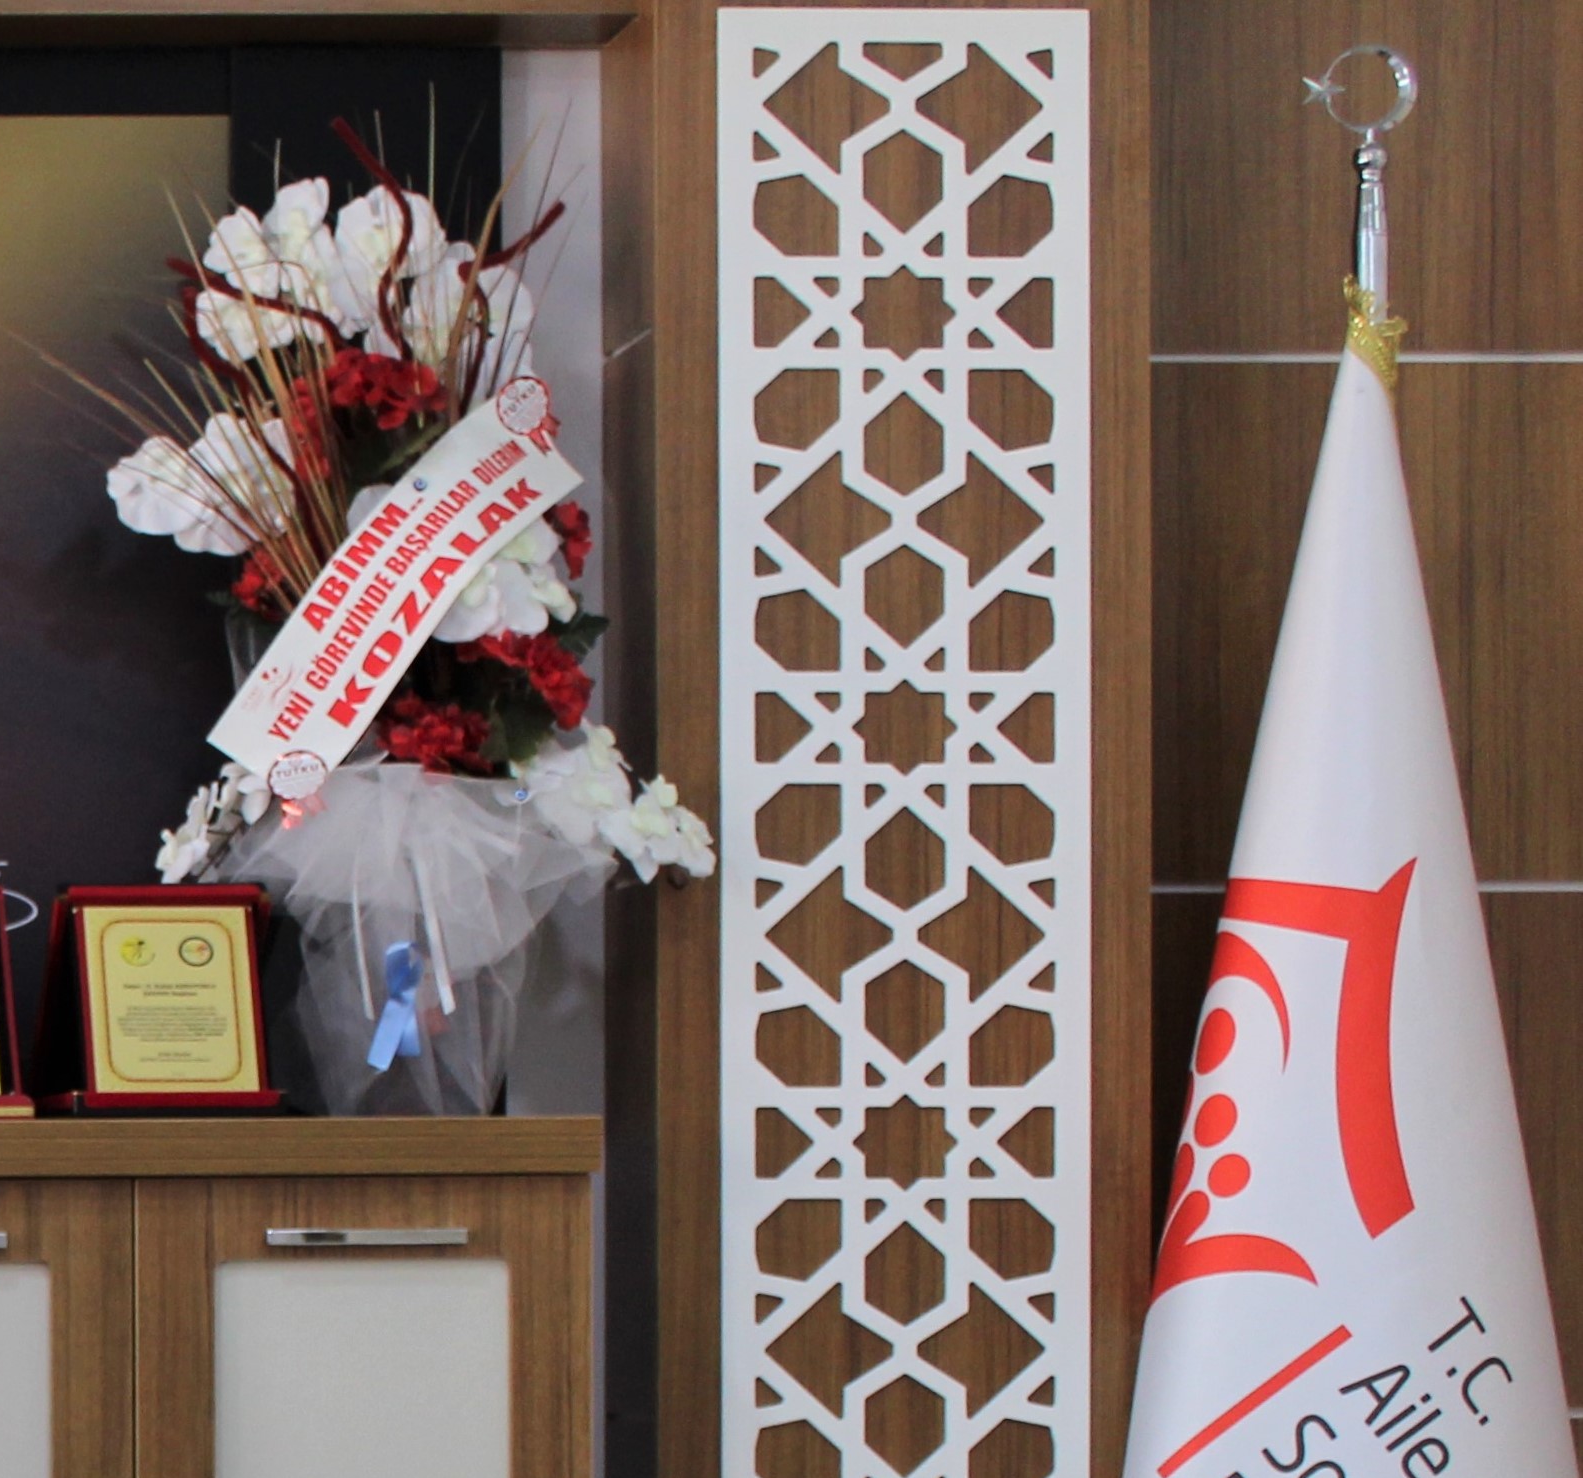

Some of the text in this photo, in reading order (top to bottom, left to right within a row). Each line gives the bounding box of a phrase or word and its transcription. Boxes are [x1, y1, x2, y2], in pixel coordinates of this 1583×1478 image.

[267, 690, 315, 742] YENİ
[305, 572, 397, 692] GÖREVİNDE
[386, 479, 481, 578] BAŞARILAR
[326, 477, 544, 729] KOZALAK
[275, 763, 320, 780] TUTKU
[1427, 1296, 1514, 1427] T.C.
